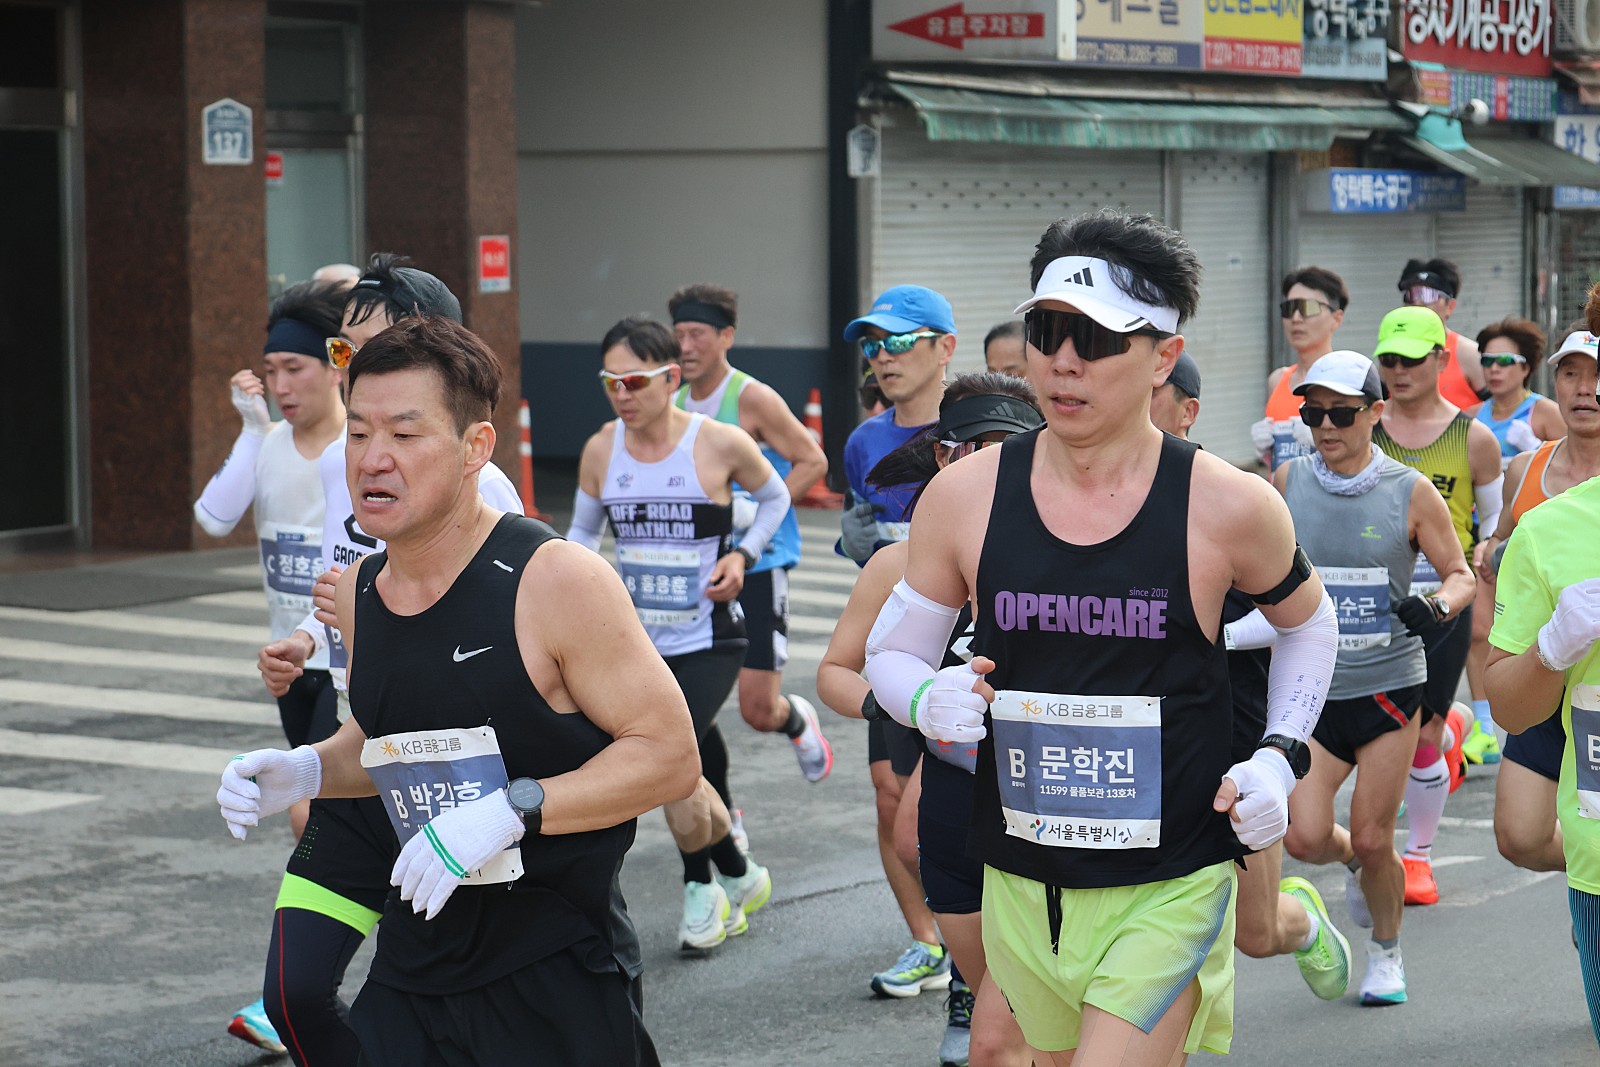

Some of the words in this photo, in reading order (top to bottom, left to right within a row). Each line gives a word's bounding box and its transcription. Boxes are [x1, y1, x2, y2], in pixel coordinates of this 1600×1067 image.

[927, 15, 1030, 38] 유료주차장
[610, 503, 693, 521] OFF-ROAD
[616, 521, 695, 540] TRIATHLON
[1129, 587, 1149, 597] since
[1151, 587, 1169, 598] 2012
[994, 590, 1168, 640] OPENCARE
[1046, 701, 1123, 719] KB금융그룹
[401, 737, 462, 756] KB금융그룹
[1008, 748, 1027, 779] B
[1039, 745, 1136, 784] 문학진
[1039, 784, 1068, 796] 11599
[1069, 786, 1104, 799] 물품보관
[1106, 787, 1137, 799] 13호차
[391, 788, 410, 820] B
[1048, 823, 1117, 844] 서울특별시
